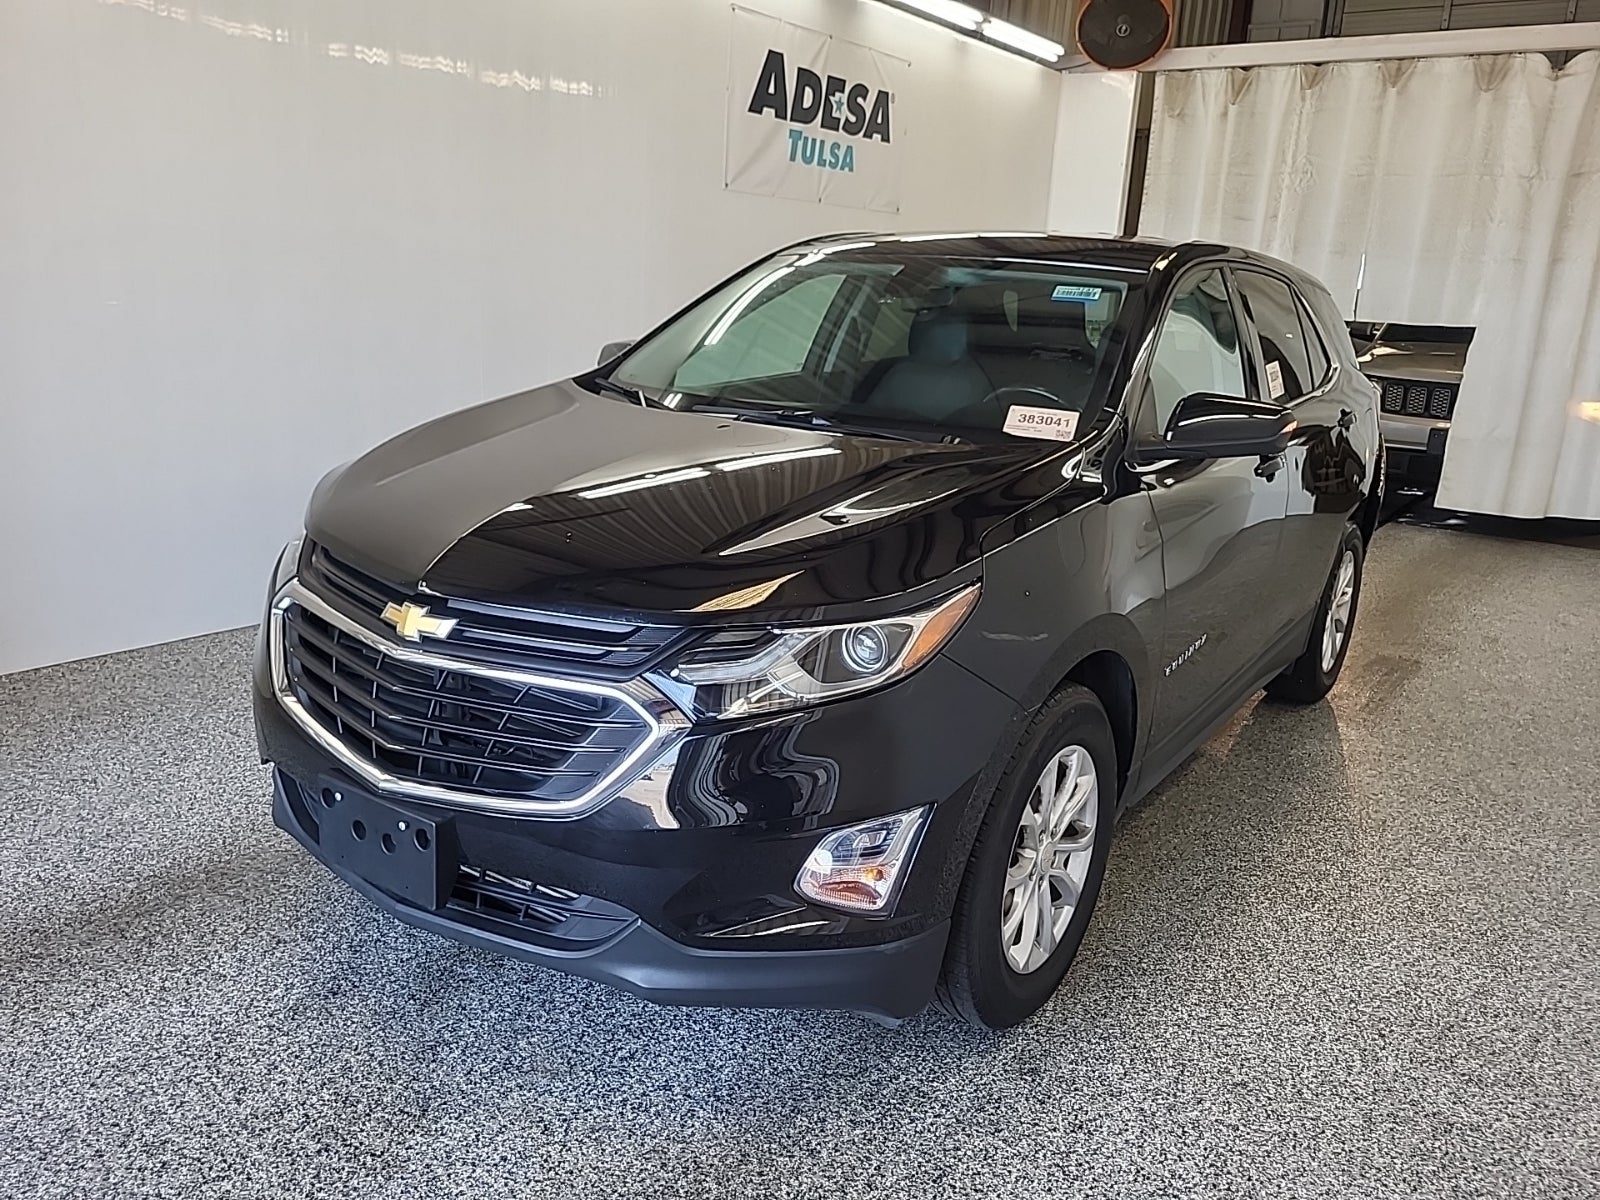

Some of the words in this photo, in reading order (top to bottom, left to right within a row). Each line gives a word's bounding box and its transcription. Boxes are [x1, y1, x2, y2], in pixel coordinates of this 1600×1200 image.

[748, 49, 891, 144] ADESA
[788, 128, 855, 173] TULSA
[1017, 413, 1072, 428] 383041
